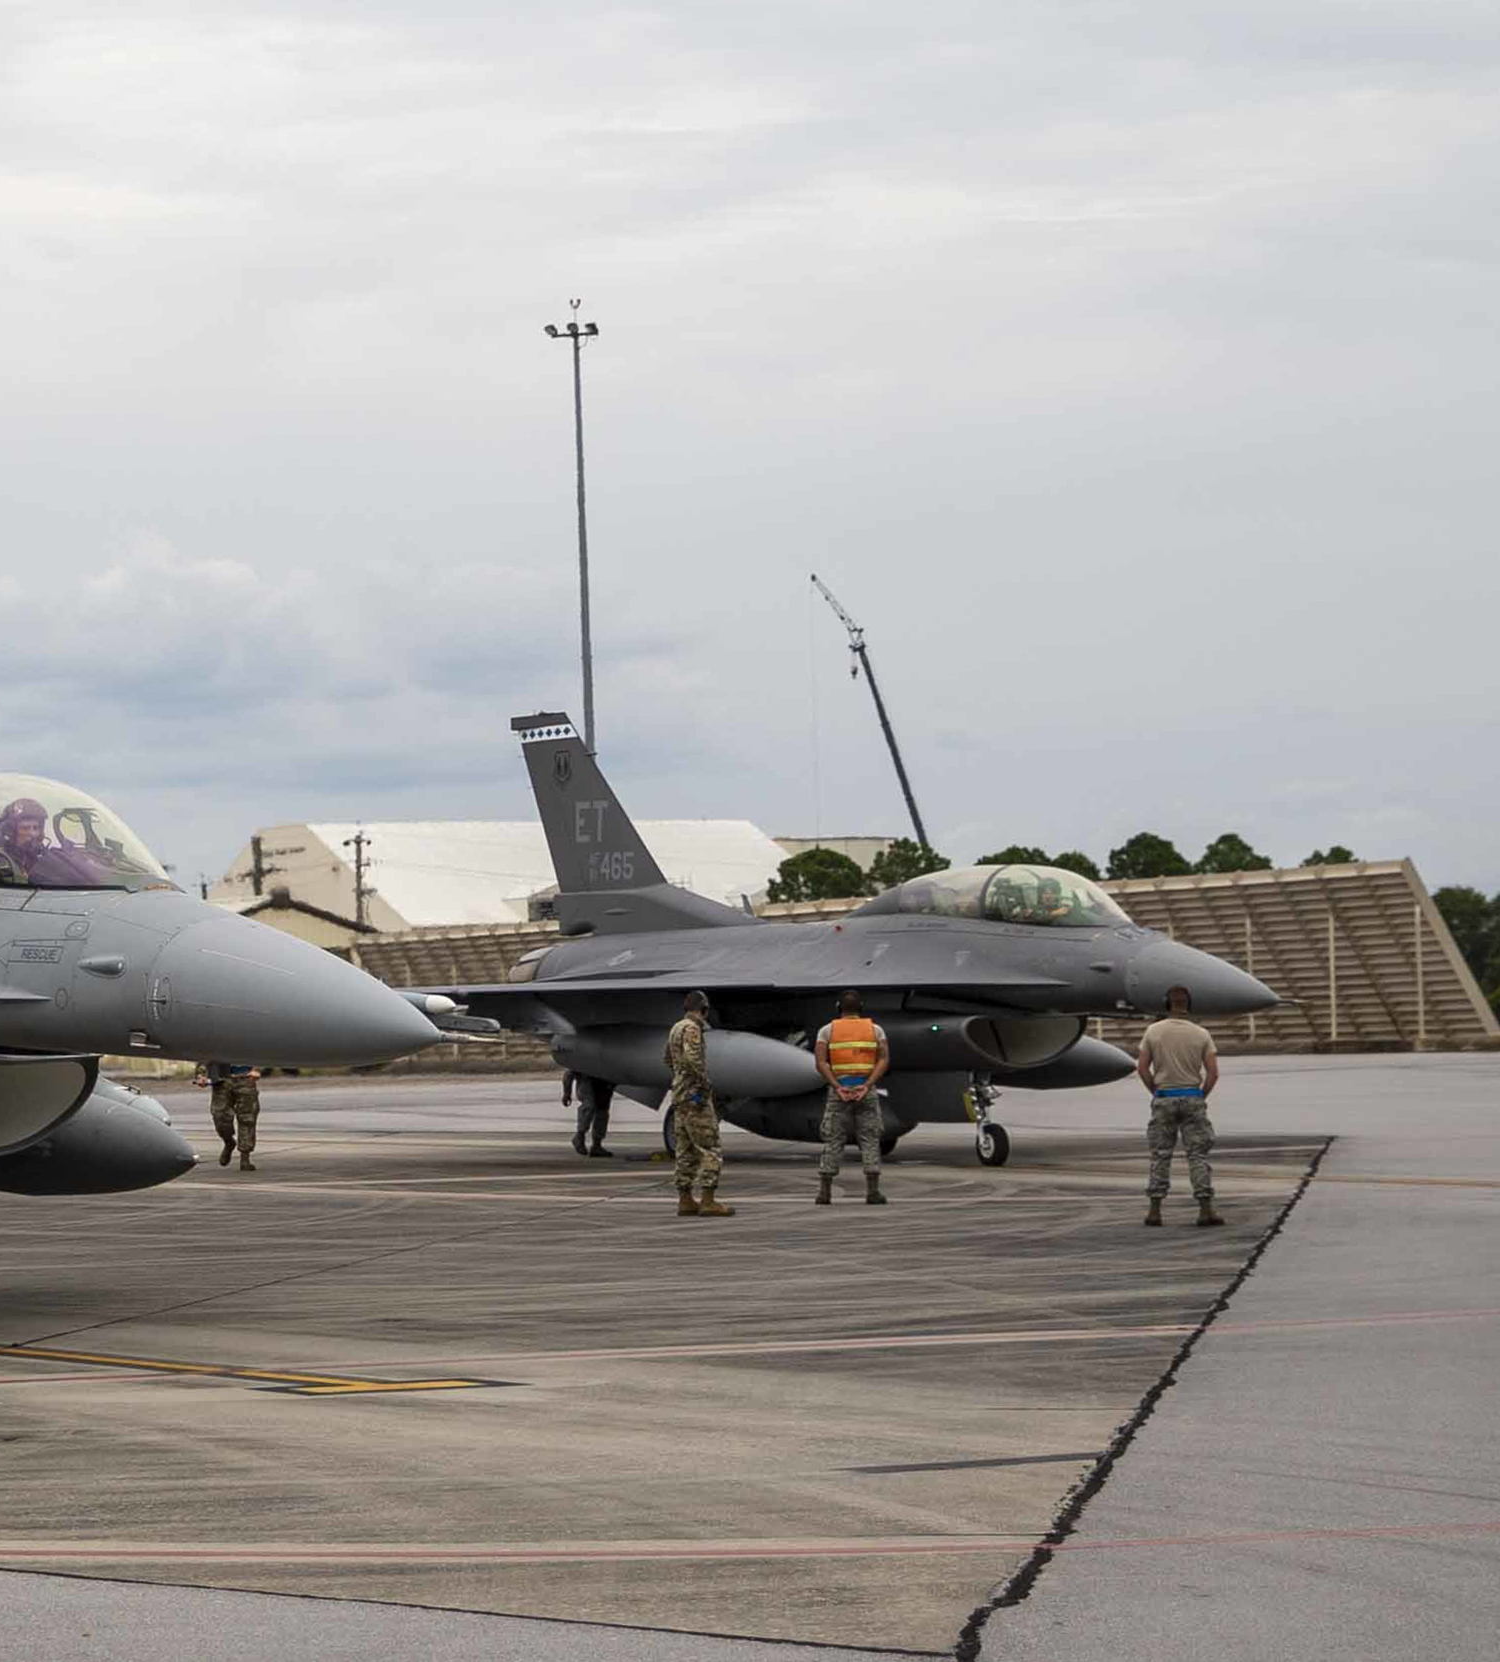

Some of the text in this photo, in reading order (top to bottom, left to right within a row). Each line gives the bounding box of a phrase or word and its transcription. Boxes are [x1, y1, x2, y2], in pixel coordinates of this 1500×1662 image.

[575, 801, 610, 843] ET
[600, 851, 635, 881] 465
[20, 947, 59, 961] RESCUE
